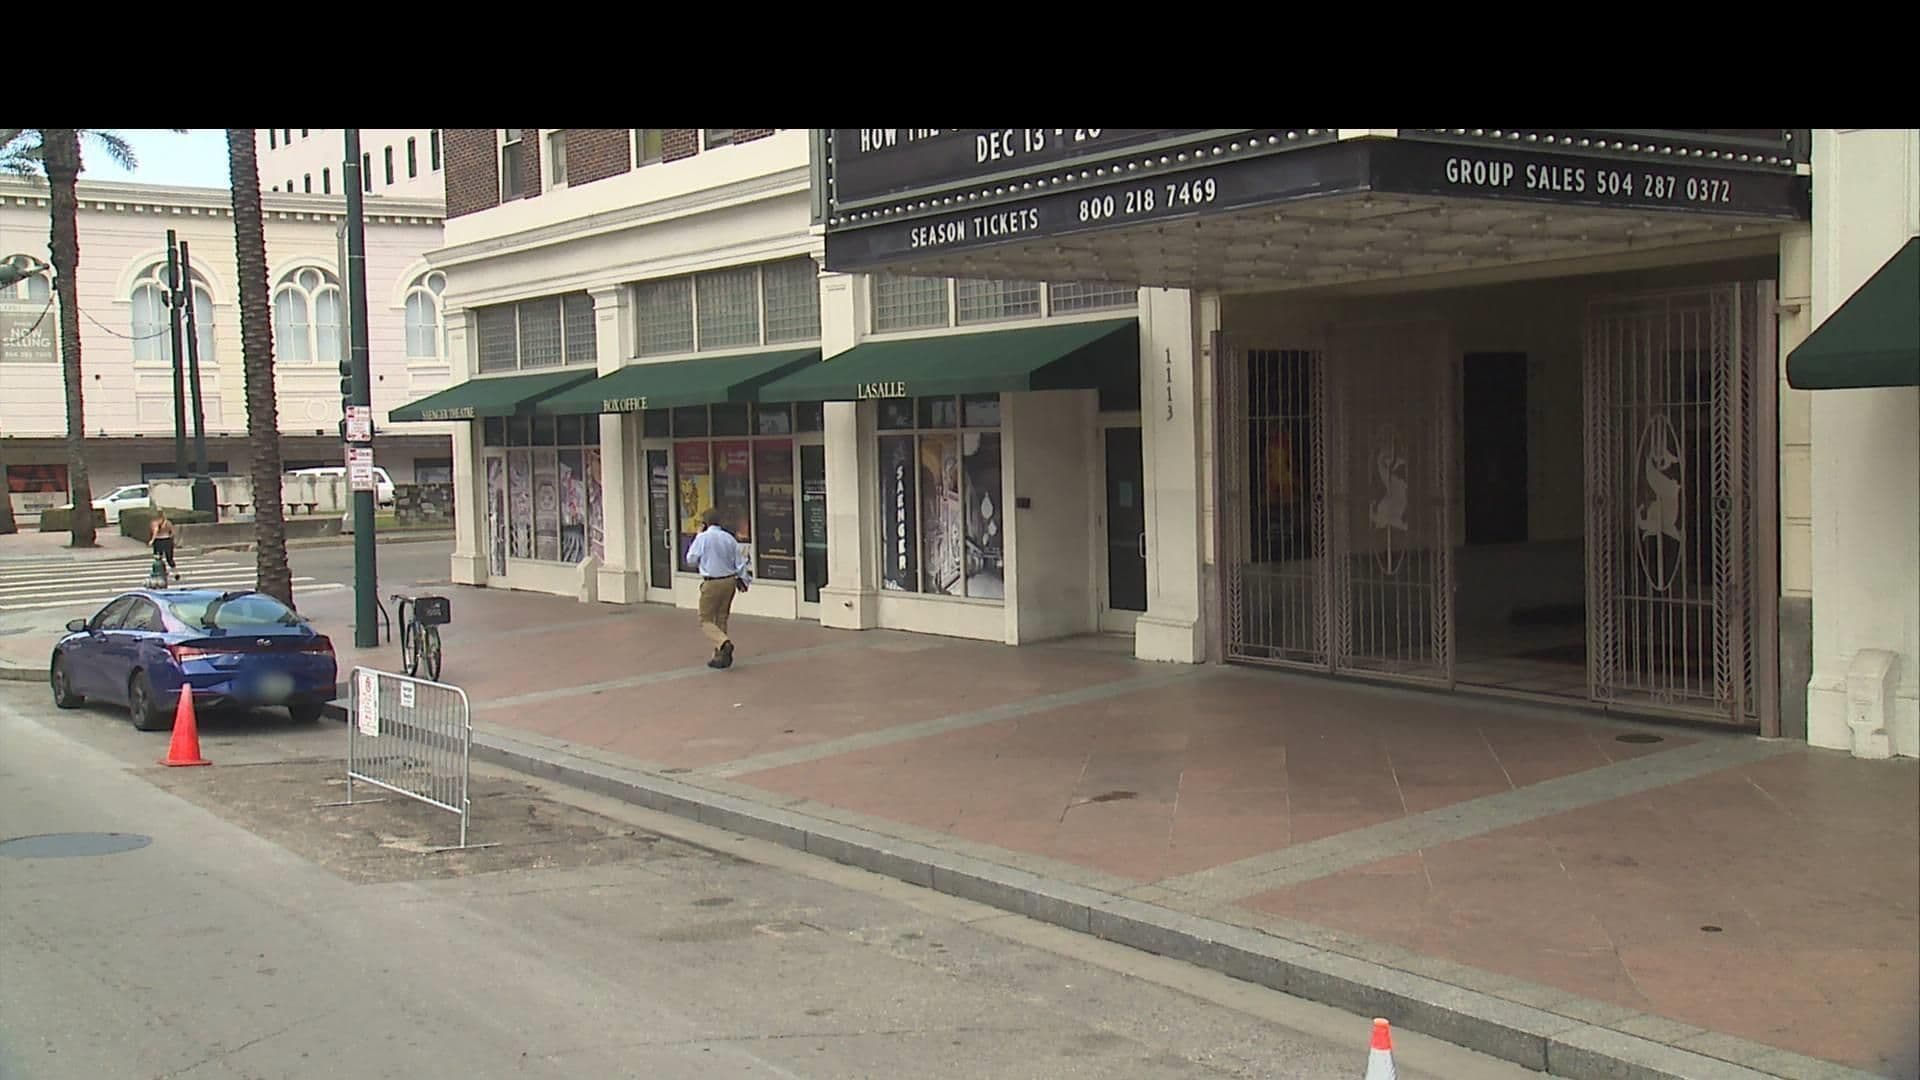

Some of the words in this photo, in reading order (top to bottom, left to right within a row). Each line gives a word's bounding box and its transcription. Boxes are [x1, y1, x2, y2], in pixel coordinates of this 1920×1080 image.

[861, 128, 897, 152] HOW
[976, 128, 1014, 162] DEC
[1024, 128, 1044, 152] 13
[1446, 158, 1514, 187] GROUP
[1526, 163, 1585, 192] SALES
[1596, 170, 1633, 196] 504
[1644, 174, 1676, 199] 287
[1686, 178, 1730, 203] 0372
[911, 220, 965, 248] SEASON
[974, 208, 1038, 238] TICKETS
[1079, 195, 1114, 222] 800
[1126, 188, 1154, 214] 218
[1166, 178, 1216, 208] 7469
[11, 328, 43, 338] NOW
[857, 381, 907, 399] LASALLE
[1166, 347, 1174, 422] 1113
[602, 399, 620, 412] BOX
[619, 396, 648, 411] OFFICE
[896, 464, 907, 571] SAENGER
